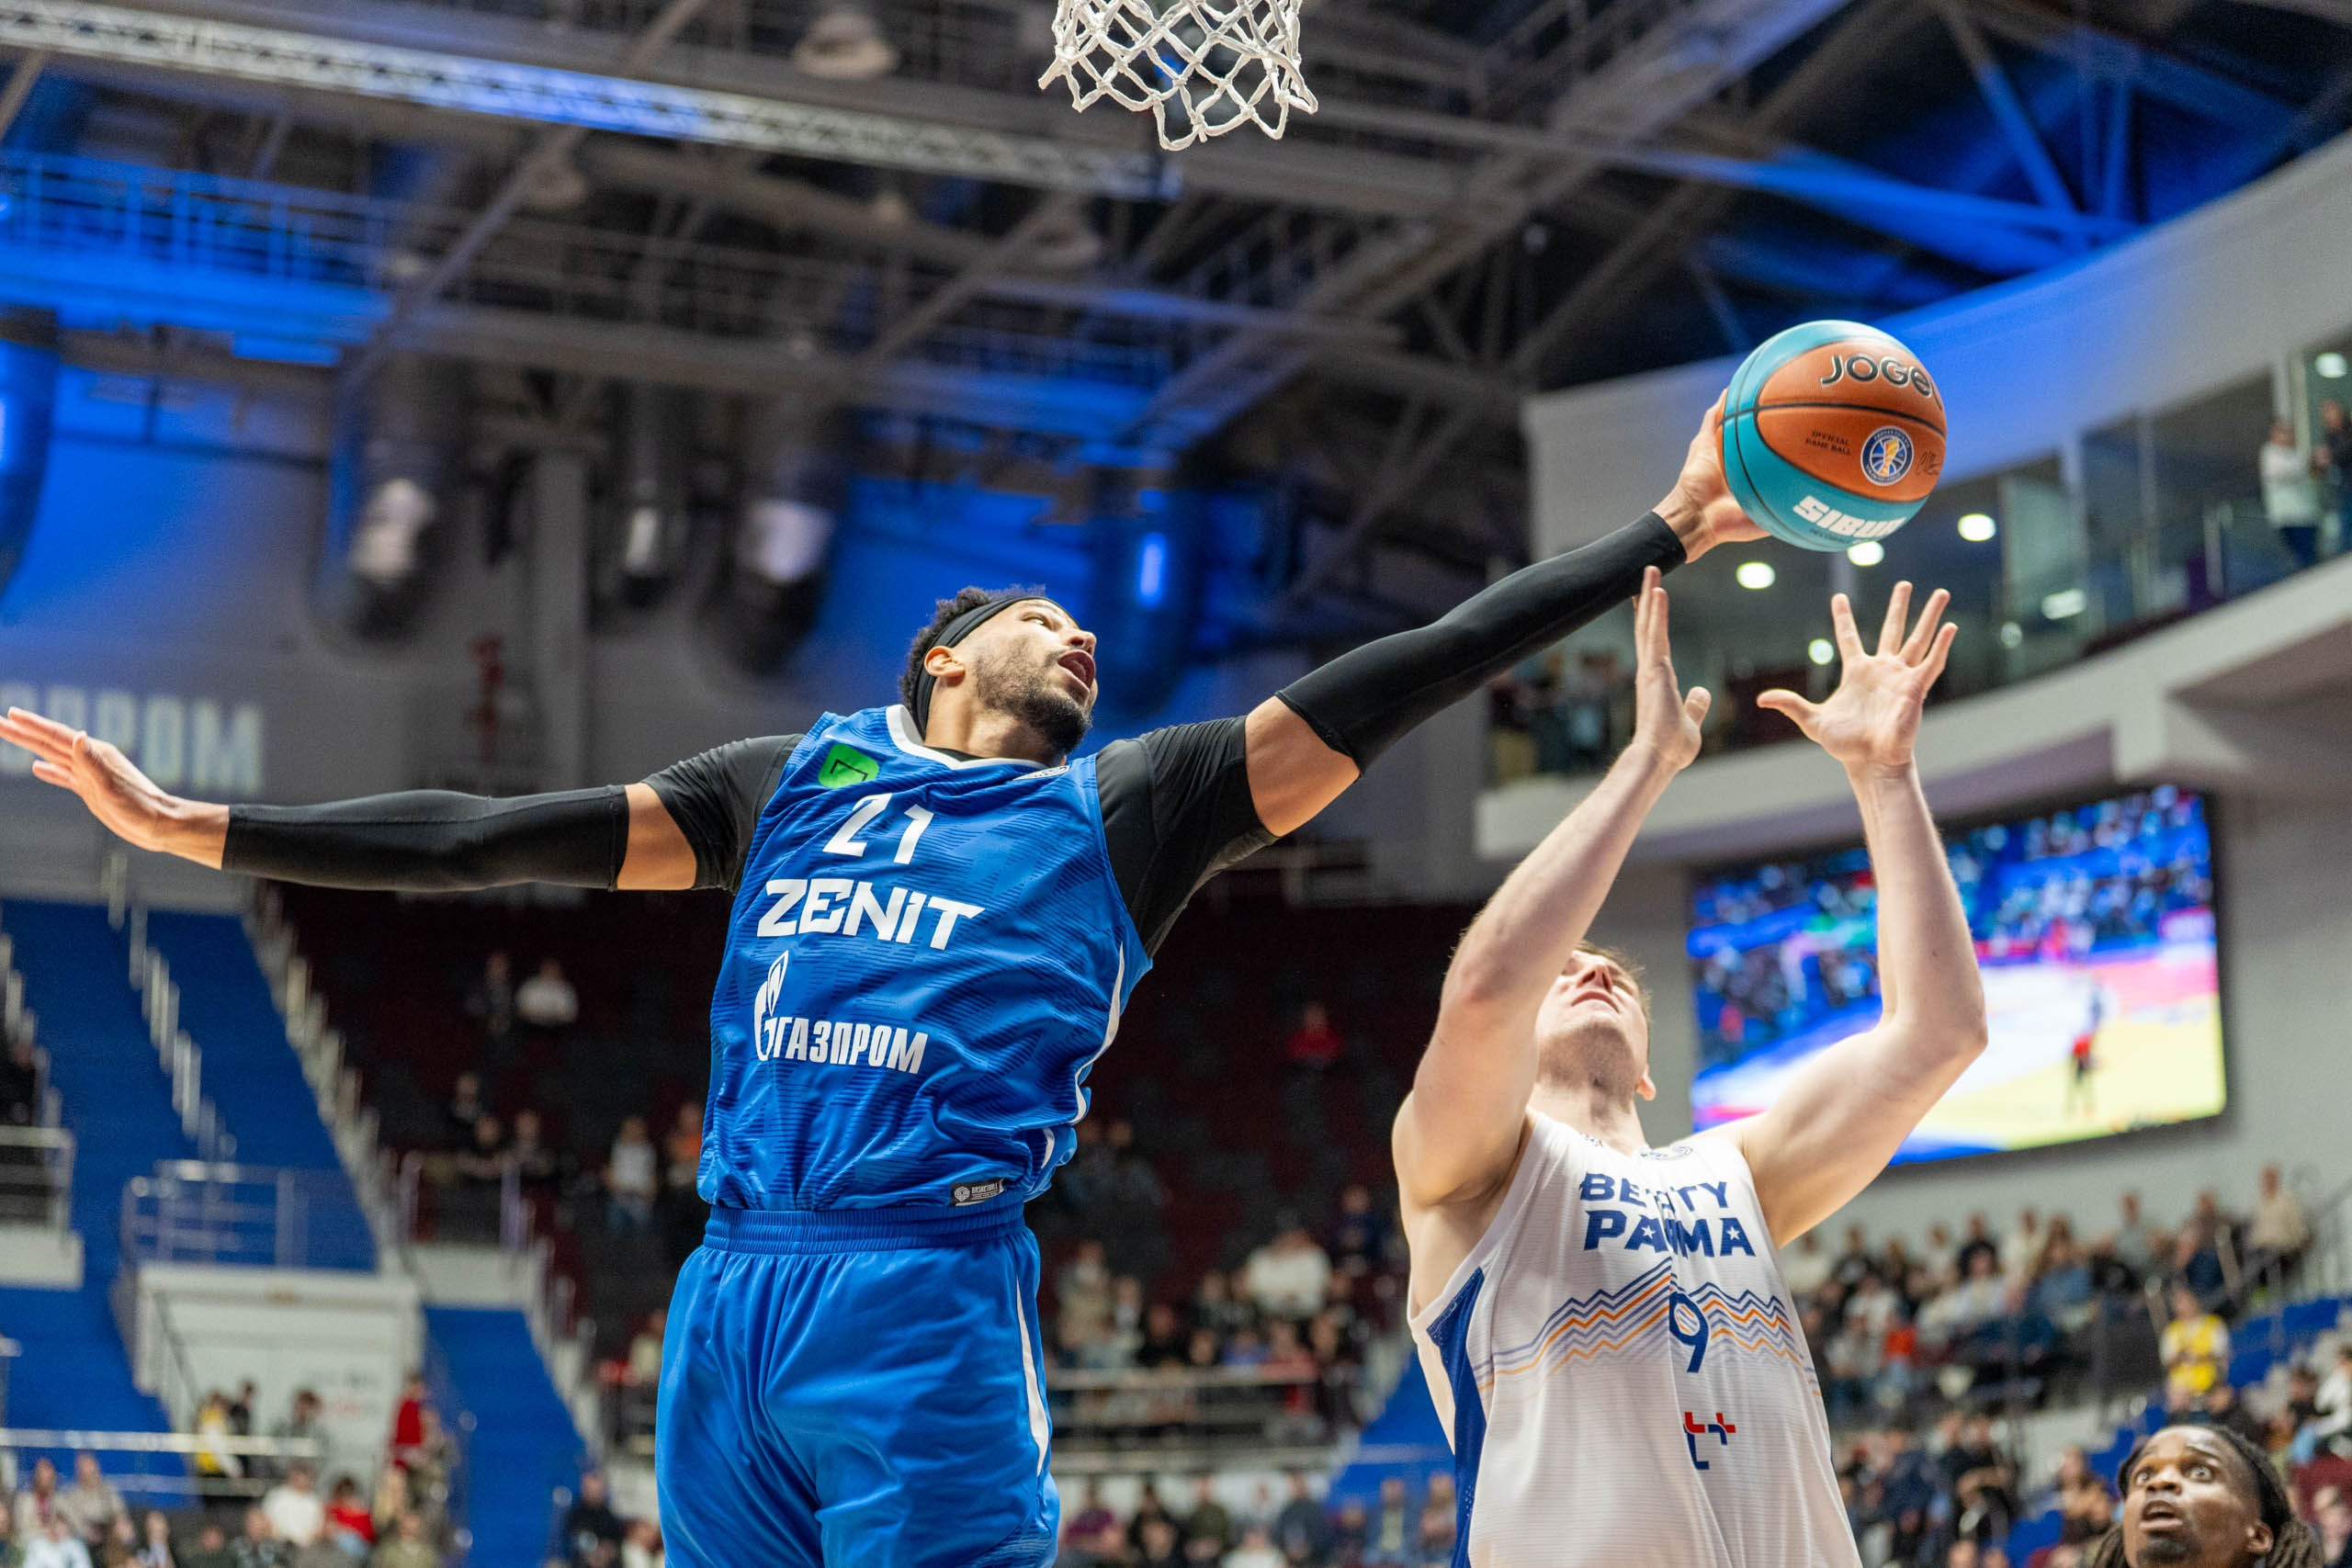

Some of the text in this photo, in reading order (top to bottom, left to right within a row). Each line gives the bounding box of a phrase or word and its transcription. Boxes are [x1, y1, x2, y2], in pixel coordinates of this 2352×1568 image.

[1812, 431, 1849, 446] OFFICIAL
[1831, 445, 1852, 456] BALL
[822, 792, 934, 864] 21
[756, 878, 986, 951] ZENIT
[773, 1016, 929, 1075] ГАЗПРОМ
[1578, 1171, 1729, 1213] BETY
[1668, 1292, 1710, 1373] 9
